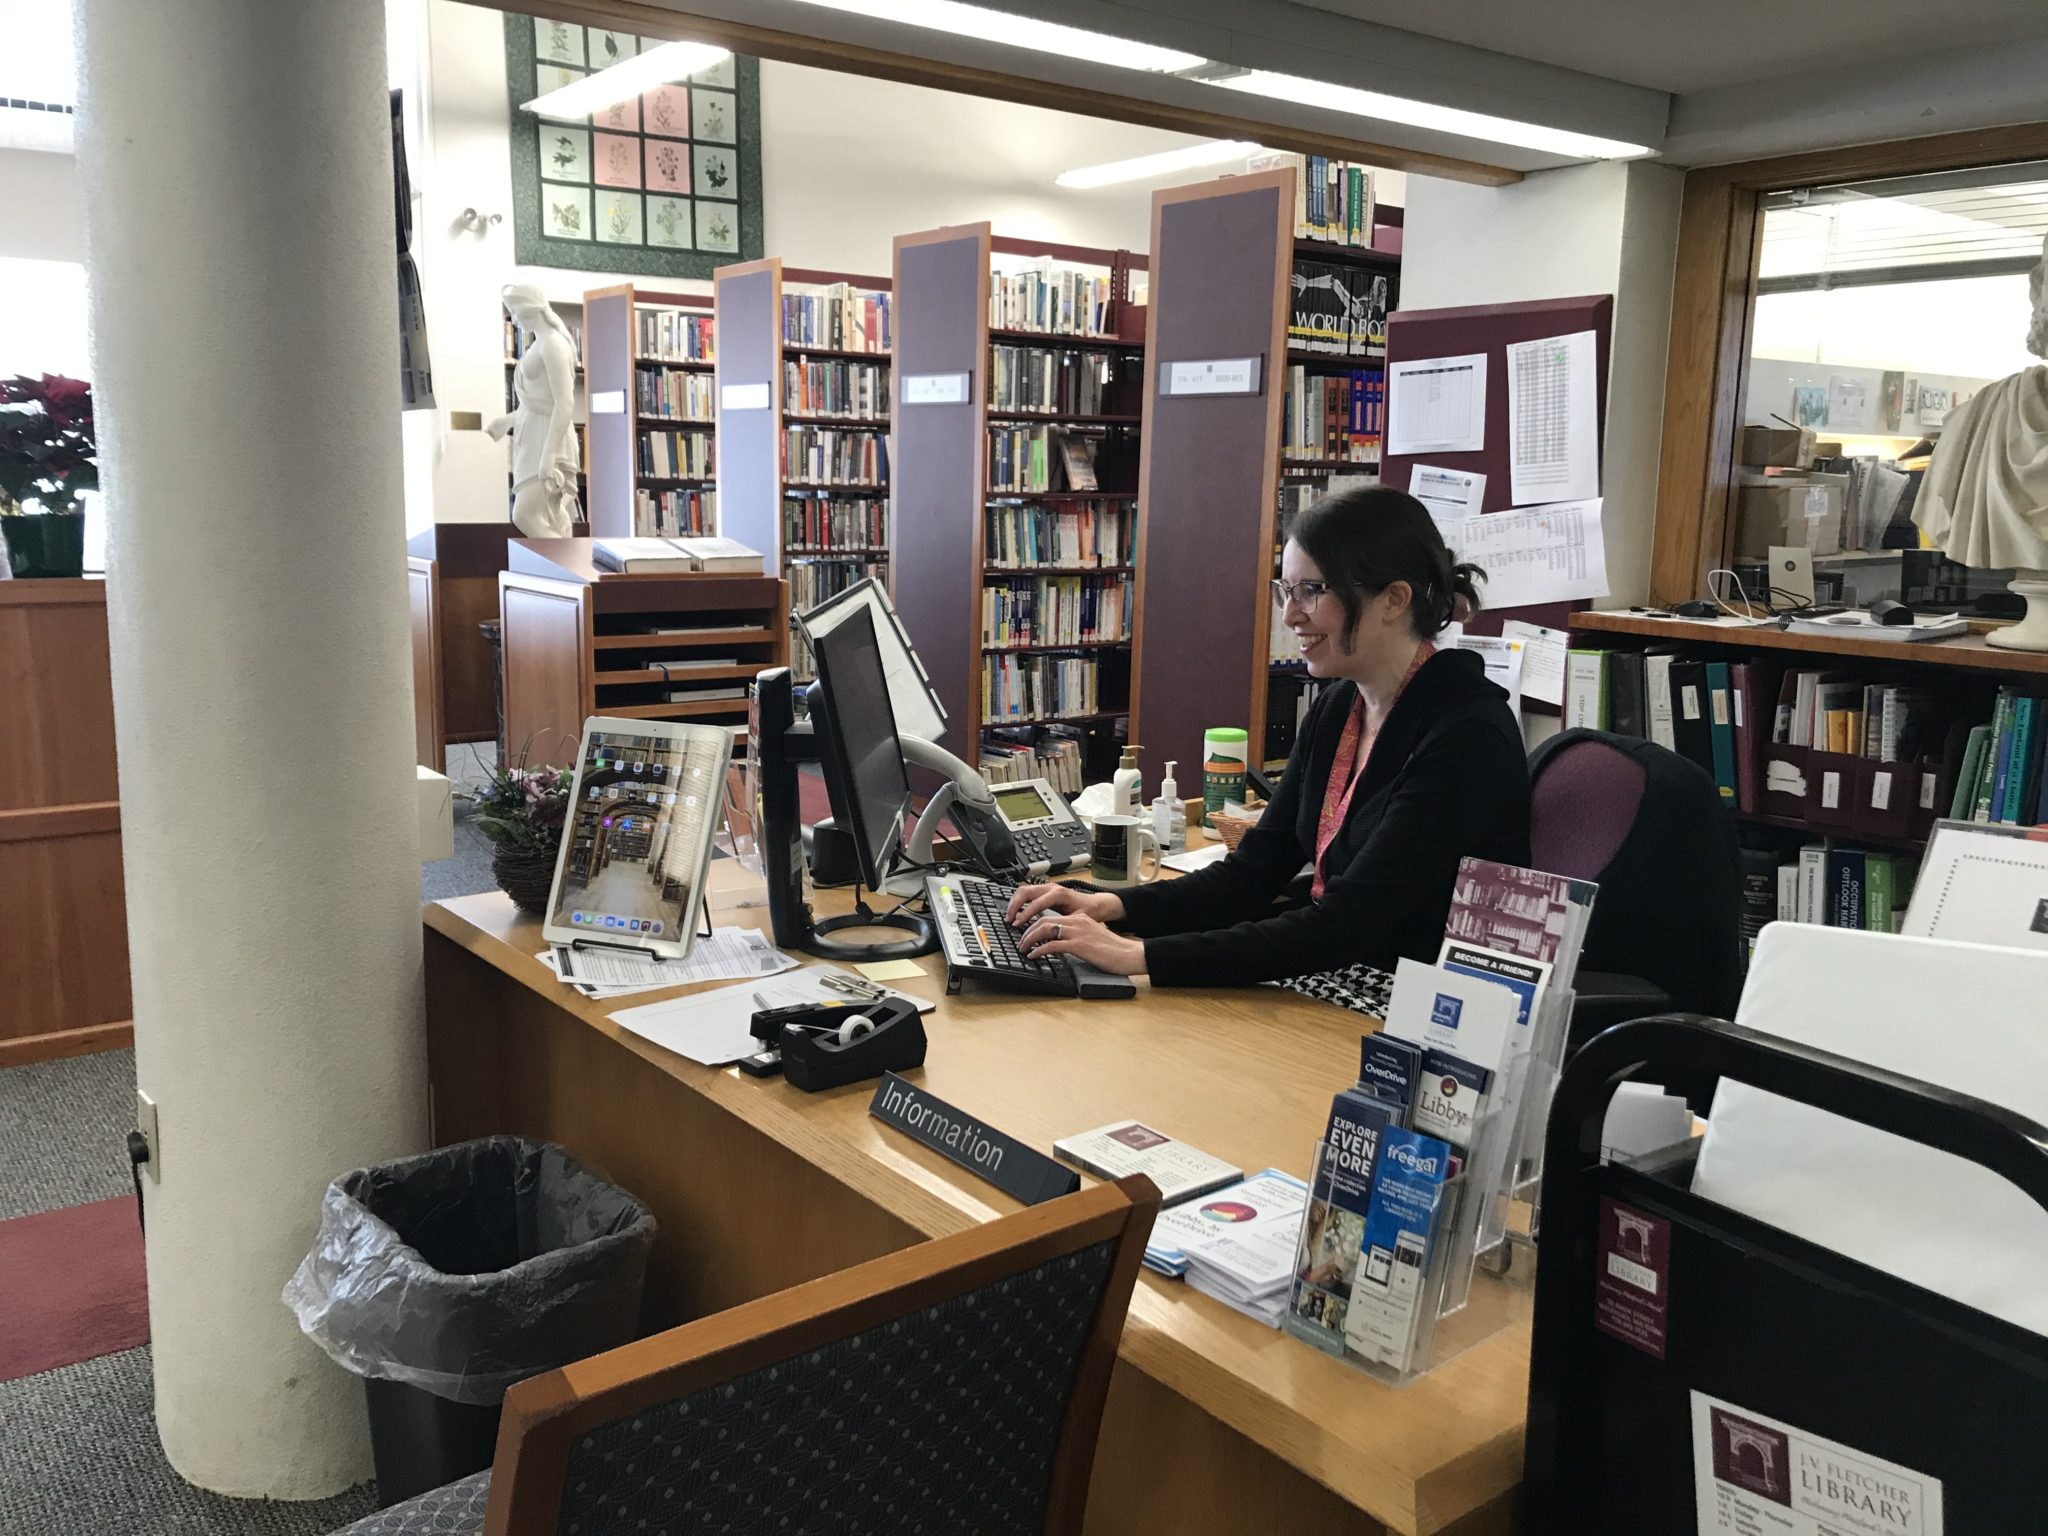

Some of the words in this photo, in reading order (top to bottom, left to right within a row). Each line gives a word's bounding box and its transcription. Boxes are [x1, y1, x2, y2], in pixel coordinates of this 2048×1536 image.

[1296, 311, 1356, 337] WORLD
[1841, 866, 1850, 912] OUTLOOK
[1454, 952, 1490, 966] BECOME
[1490, 962, 1498, 970] A
[1498, 964, 1534, 978] FRIEND!
[1364, 1063, 1407, 1086] OverDrive
[882, 1080, 1004, 1172] Information
[1333, 1115, 1378, 1142] EXPLORE
[1330, 1128, 1376, 1160] EVEN
[1387, 1144, 1438, 1175] freegal
[1326, 1146, 1372, 1178] MORE
[1801, 1470, 1912, 1527] LIBRARY
[1827, 1462, 1910, 1504] FLETCHER
